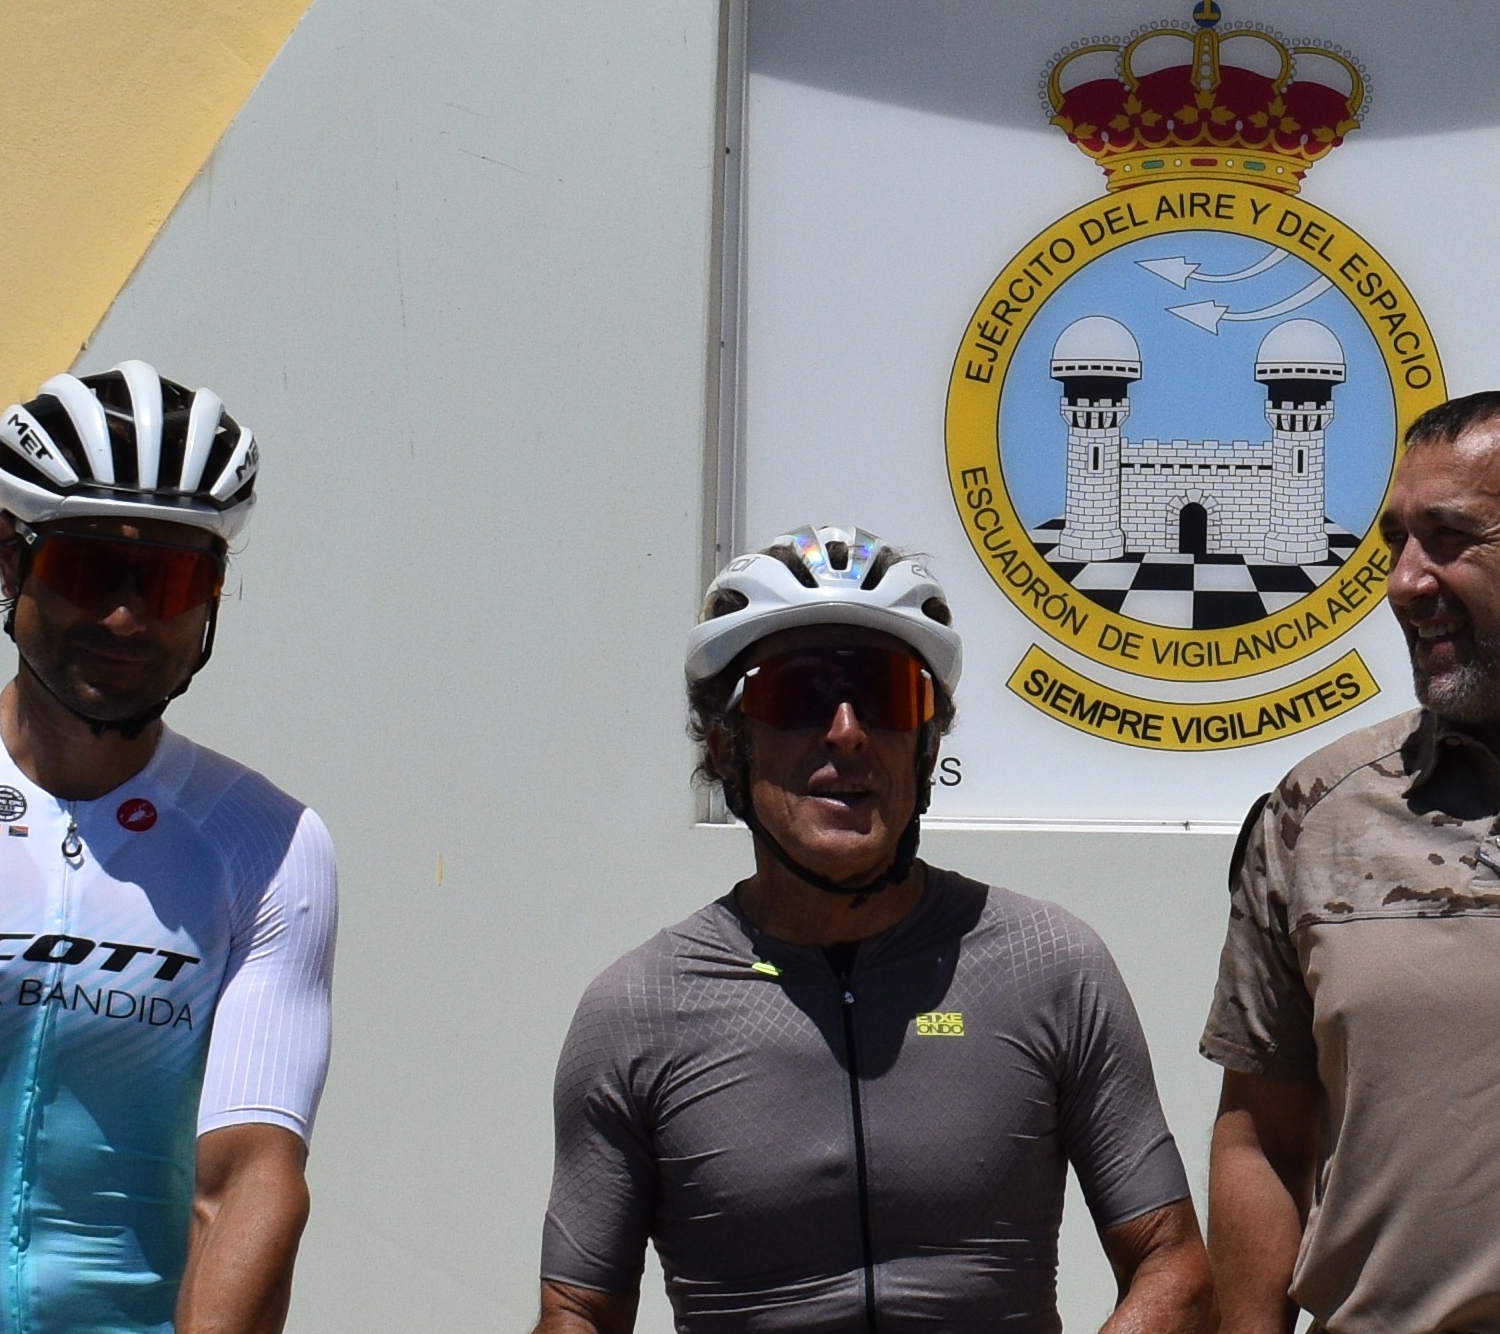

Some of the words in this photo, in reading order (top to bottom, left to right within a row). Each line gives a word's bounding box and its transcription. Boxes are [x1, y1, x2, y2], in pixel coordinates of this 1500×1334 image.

[965, 238, 1076, 384] EJÉRCITO
[1079, 203, 1149, 246] DEL
[1155, 192, 1236, 222] AIRE
[1250, 198, 1271, 225] Y
[1276, 209, 1336, 262] DEL
[1339, 252, 1432, 390] ESPACIO
[7, 413, 54, 460] MET
[961, 466, 1089, 635] ESCUADRÓN
[1098, 623, 1144, 661] DE
[1152, 611, 1329, 668] VIGILANCIA
[1326, 548, 1391, 624] AÉRE
[1023, 669, 1165, 743] SIEMPRE
[1171, 672, 1361, 744] VIGILANTES
[18, 978, 194, 1031] BANDIDA
[918, 1023, 964, 1035] ONDO
